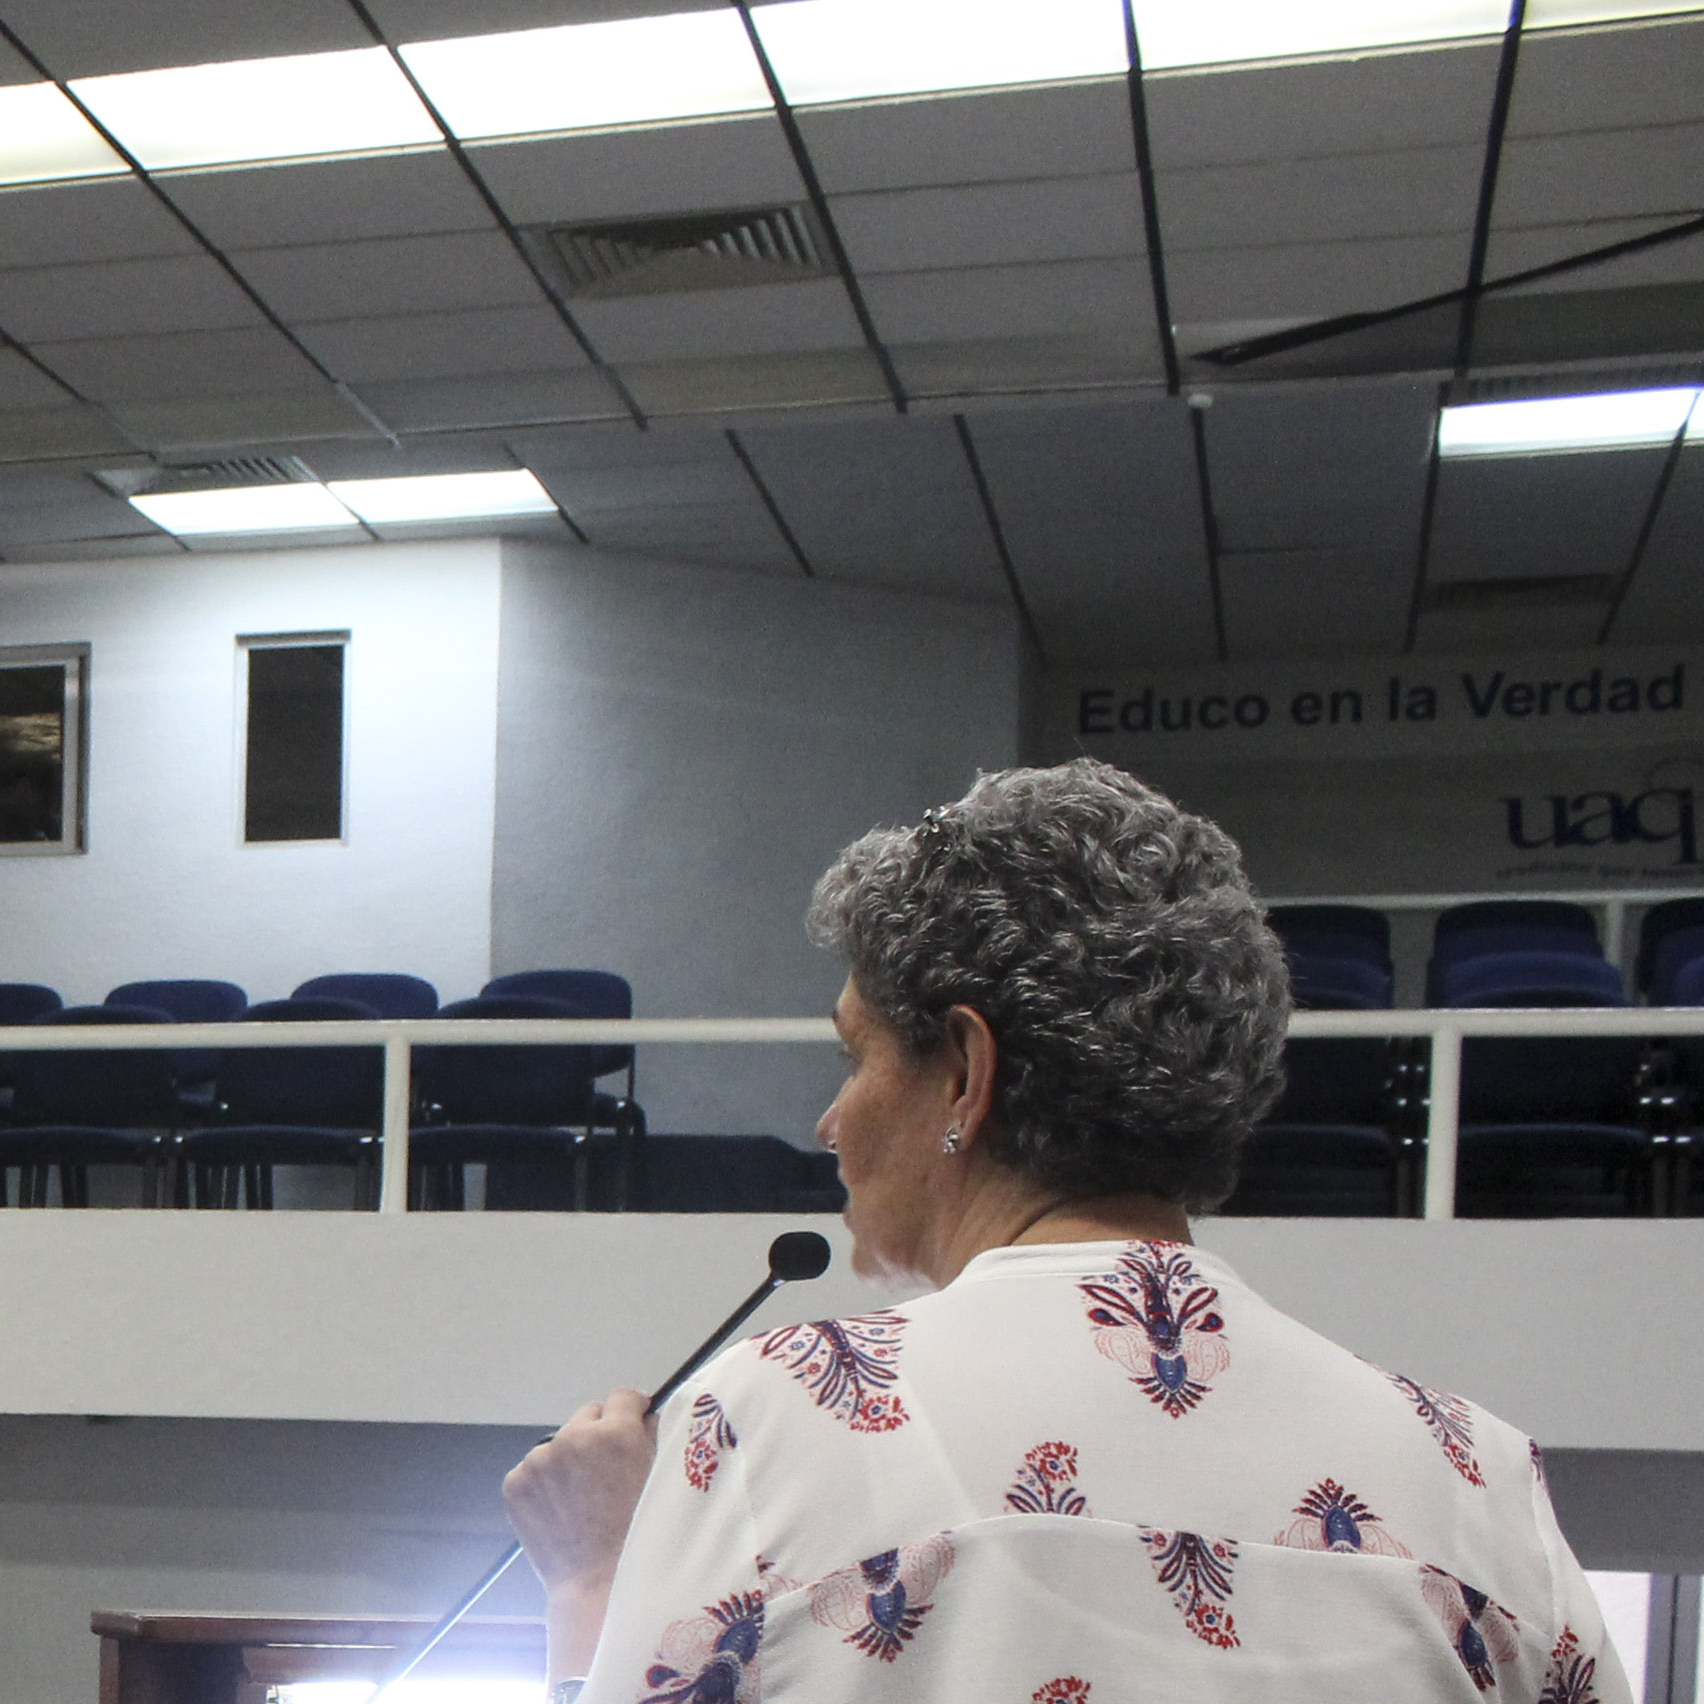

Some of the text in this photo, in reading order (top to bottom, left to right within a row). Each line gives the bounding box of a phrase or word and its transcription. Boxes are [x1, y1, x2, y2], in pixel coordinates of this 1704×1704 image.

[1078, 663, 1686, 734] Educo en la Verdad
[1497, 786, 1703, 866] uaq
